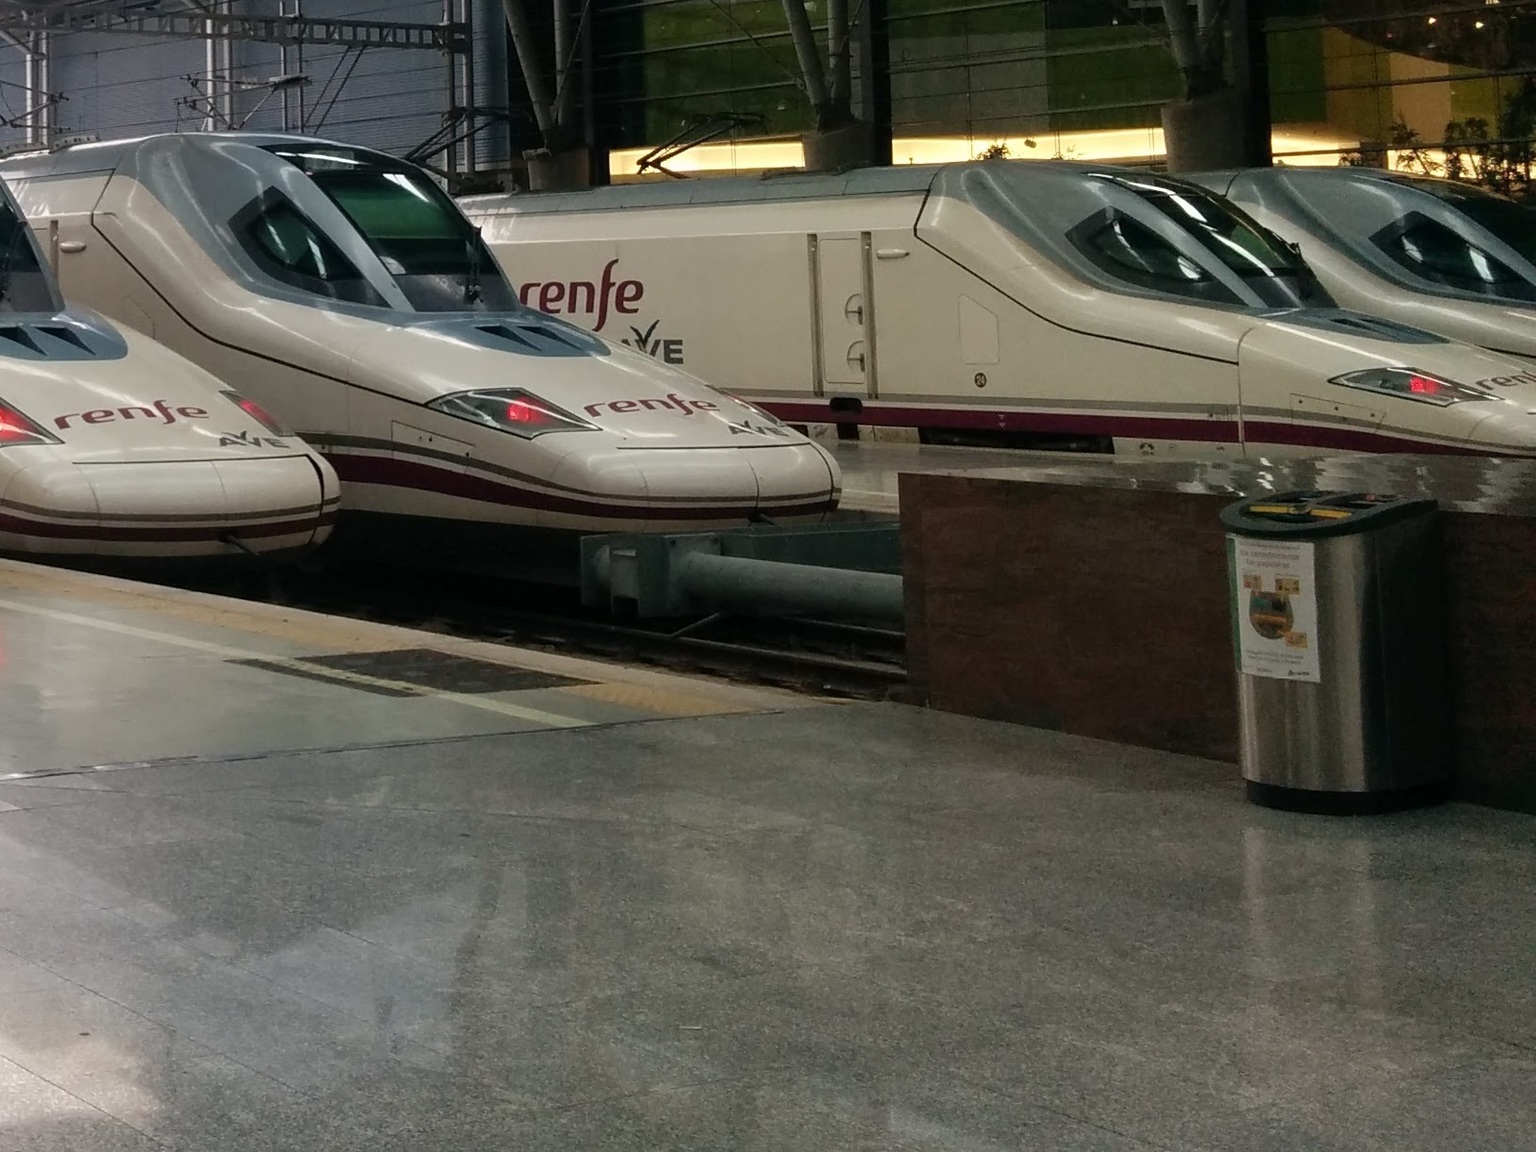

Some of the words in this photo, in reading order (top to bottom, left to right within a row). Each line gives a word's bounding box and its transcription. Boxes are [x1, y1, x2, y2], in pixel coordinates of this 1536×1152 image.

[520, 259, 644, 332] renfe
[54, 399, 210, 430] renfe
[583, 393, 721, 417] renfe
[219, 430, 290, 449] AVE
